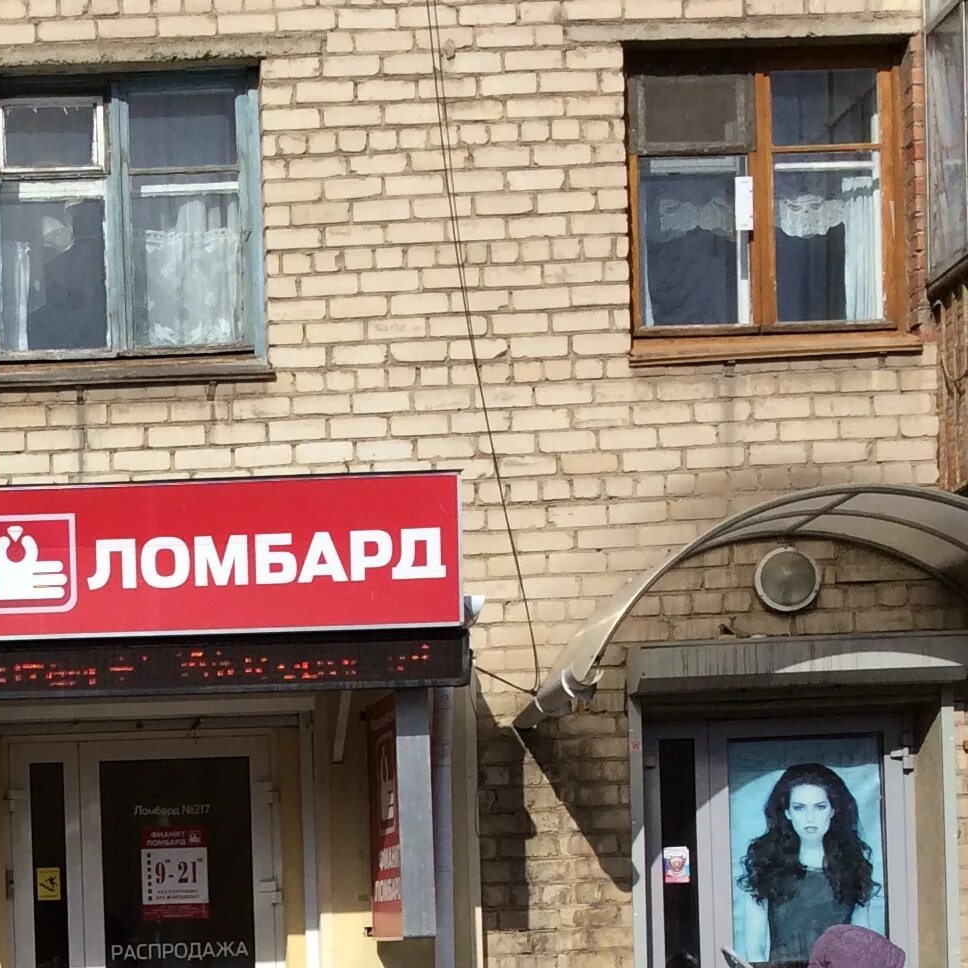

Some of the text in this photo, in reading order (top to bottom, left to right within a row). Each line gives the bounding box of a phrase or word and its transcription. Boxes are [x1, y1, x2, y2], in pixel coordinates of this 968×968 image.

[87, 527, 447, 591] ЛОМБАРД
[133, 803, 211, 816] Ломбард №217
[150, 830, 185, 839] ФИАНИТ
[146, 838, 186, 847] ЛОМБАРД
[111, 941, 249, 961] РАСПРОДАЖА
